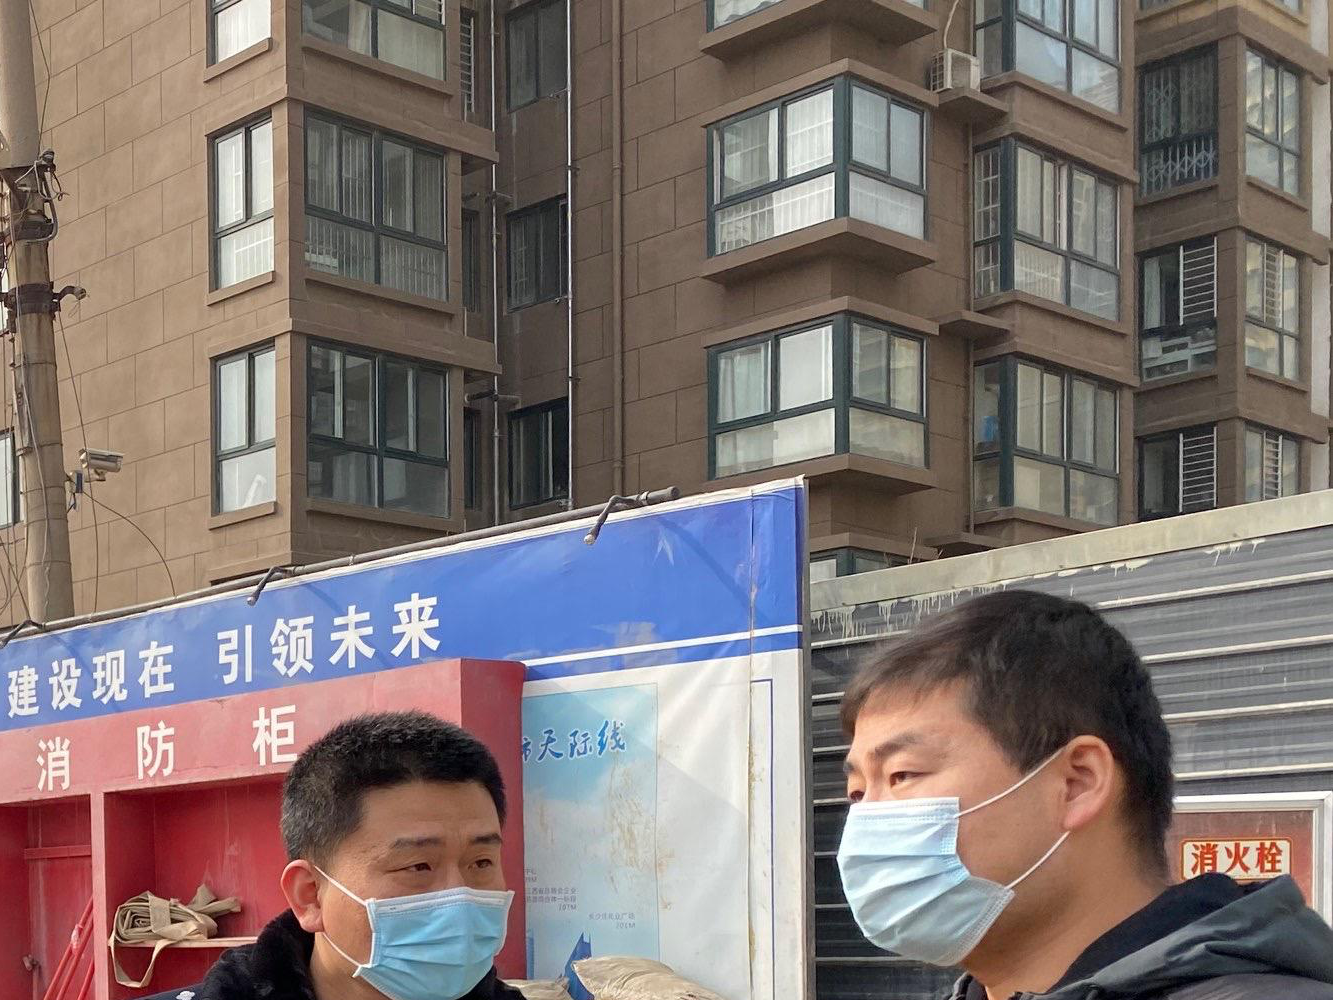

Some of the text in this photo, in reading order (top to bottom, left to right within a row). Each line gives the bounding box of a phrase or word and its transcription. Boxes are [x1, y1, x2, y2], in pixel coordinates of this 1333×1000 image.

[7, 592, 441, 719] 建设现在 引领未来
[35, 704, 299, 792] 消防柜
[1191, 842, 1283, 874] 消火栓
